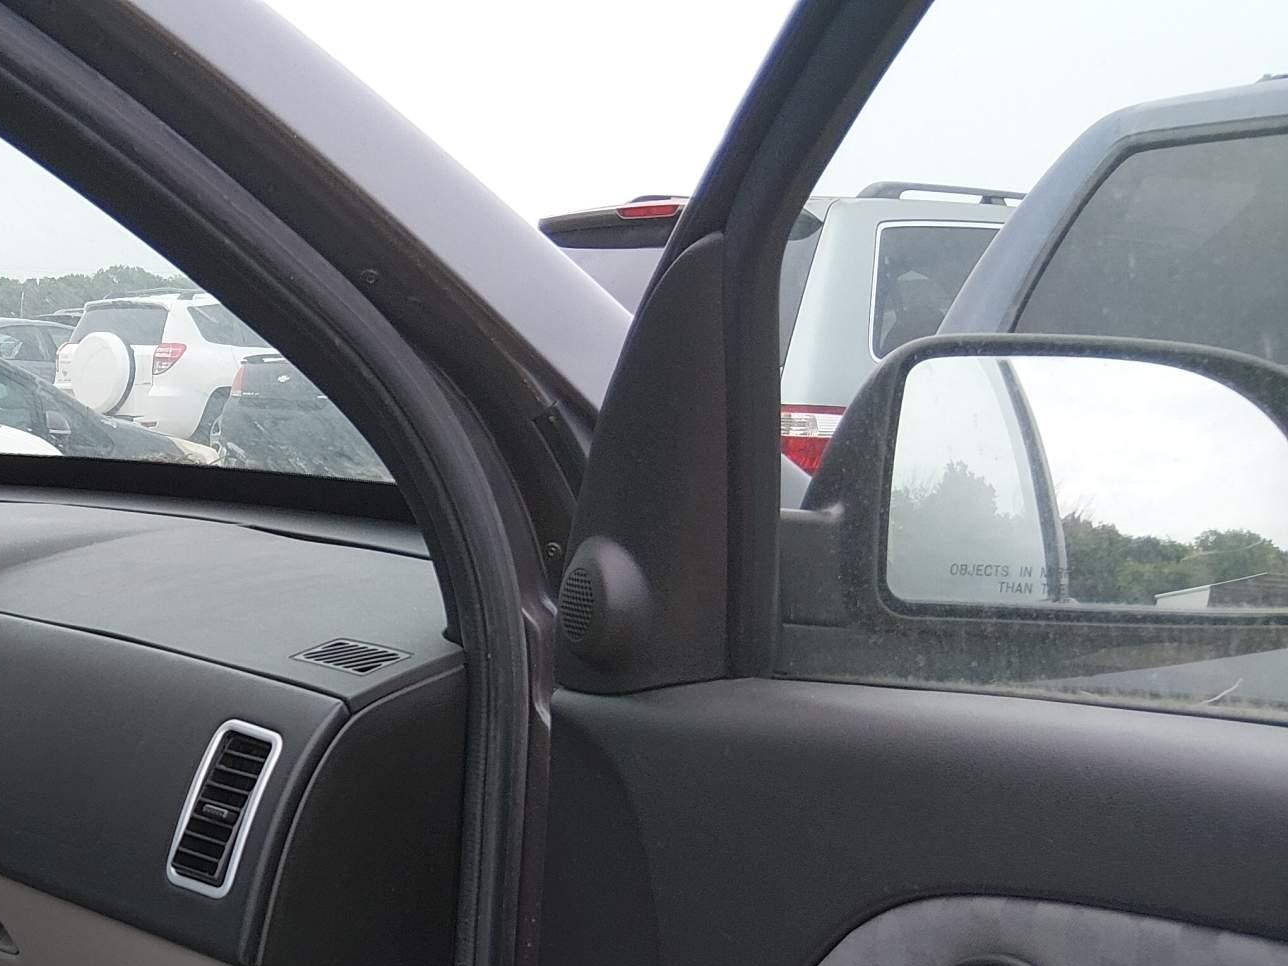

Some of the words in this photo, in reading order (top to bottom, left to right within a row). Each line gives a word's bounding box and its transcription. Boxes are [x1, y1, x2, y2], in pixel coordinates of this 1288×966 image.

[950, 563, 1009, 577] OBJECTS
[1018, 566, 1033, 578] IN
[999, 582, 1033, 594] THAN
